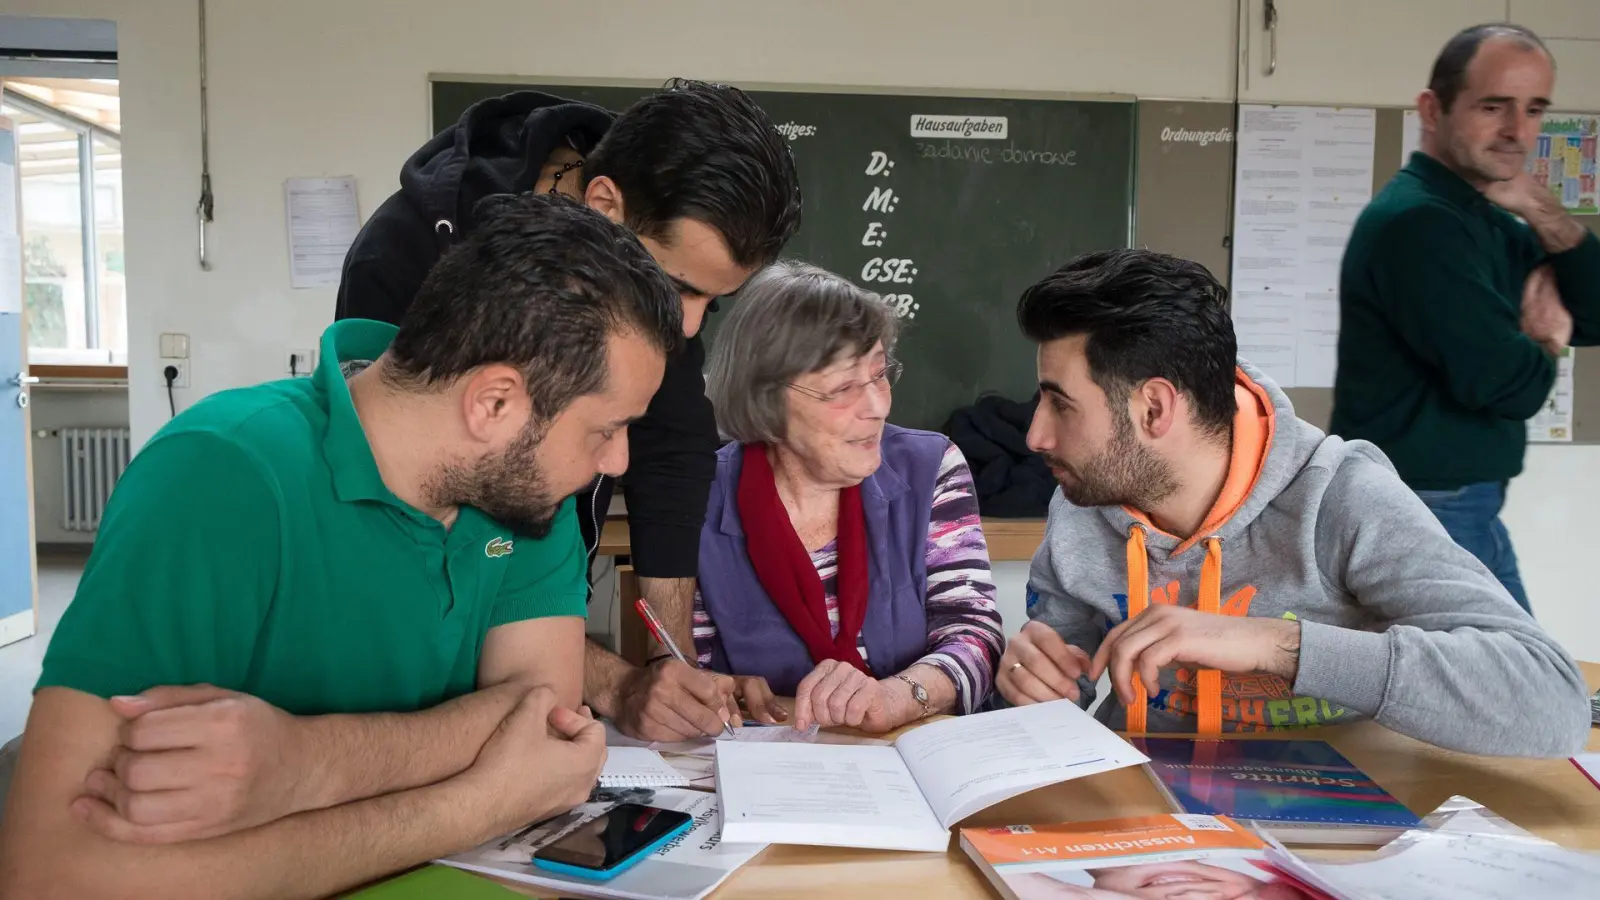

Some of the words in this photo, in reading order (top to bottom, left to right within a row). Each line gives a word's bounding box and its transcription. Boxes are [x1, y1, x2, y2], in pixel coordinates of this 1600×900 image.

[774, 120, 817, 141] stiges:
[914, 116, 1004, 137] Hausaufgaben
[1160, 126, 1234, 147] Ordnungsdie
[864, 150, 896, 177] D:
[861, 185, 900, 214] M:
[861, 221, 888, 248] E:
[860, 256, 919, 285] GSE:
[1232, 772, 1356, 789] Schritte
[1021, 846, 1059, 858] A1.1
[1066, 834, 1196, 854] Aussichten
